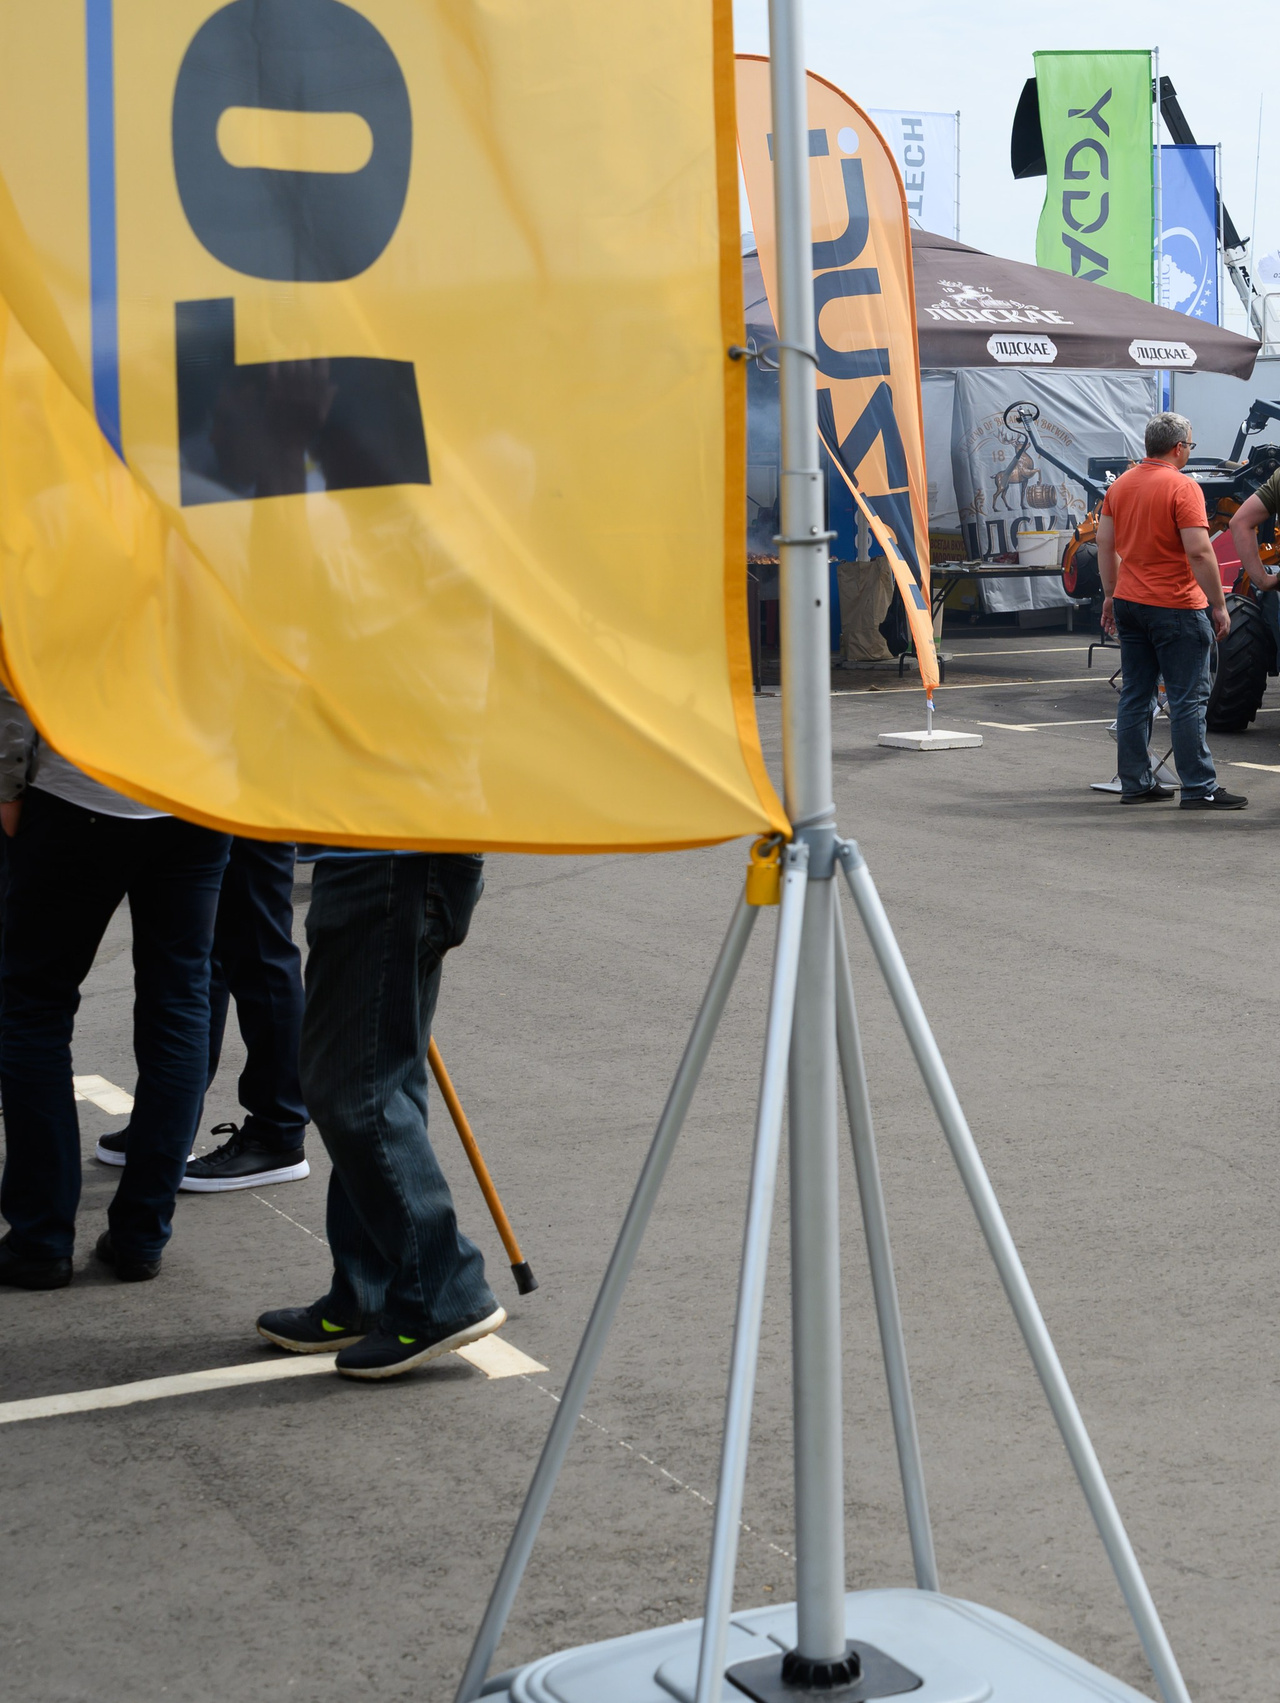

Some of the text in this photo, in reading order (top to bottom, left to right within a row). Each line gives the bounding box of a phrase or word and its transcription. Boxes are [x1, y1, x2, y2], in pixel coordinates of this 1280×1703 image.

[924, 307, 1075, 325] ЛІДСКАЕ
[995, 341, 1051, 357] ЛІДСКАЕ
[1136, 346, 1191, 361] ЛІДСКАЕ
[992, 450, 1006, 463] 18
